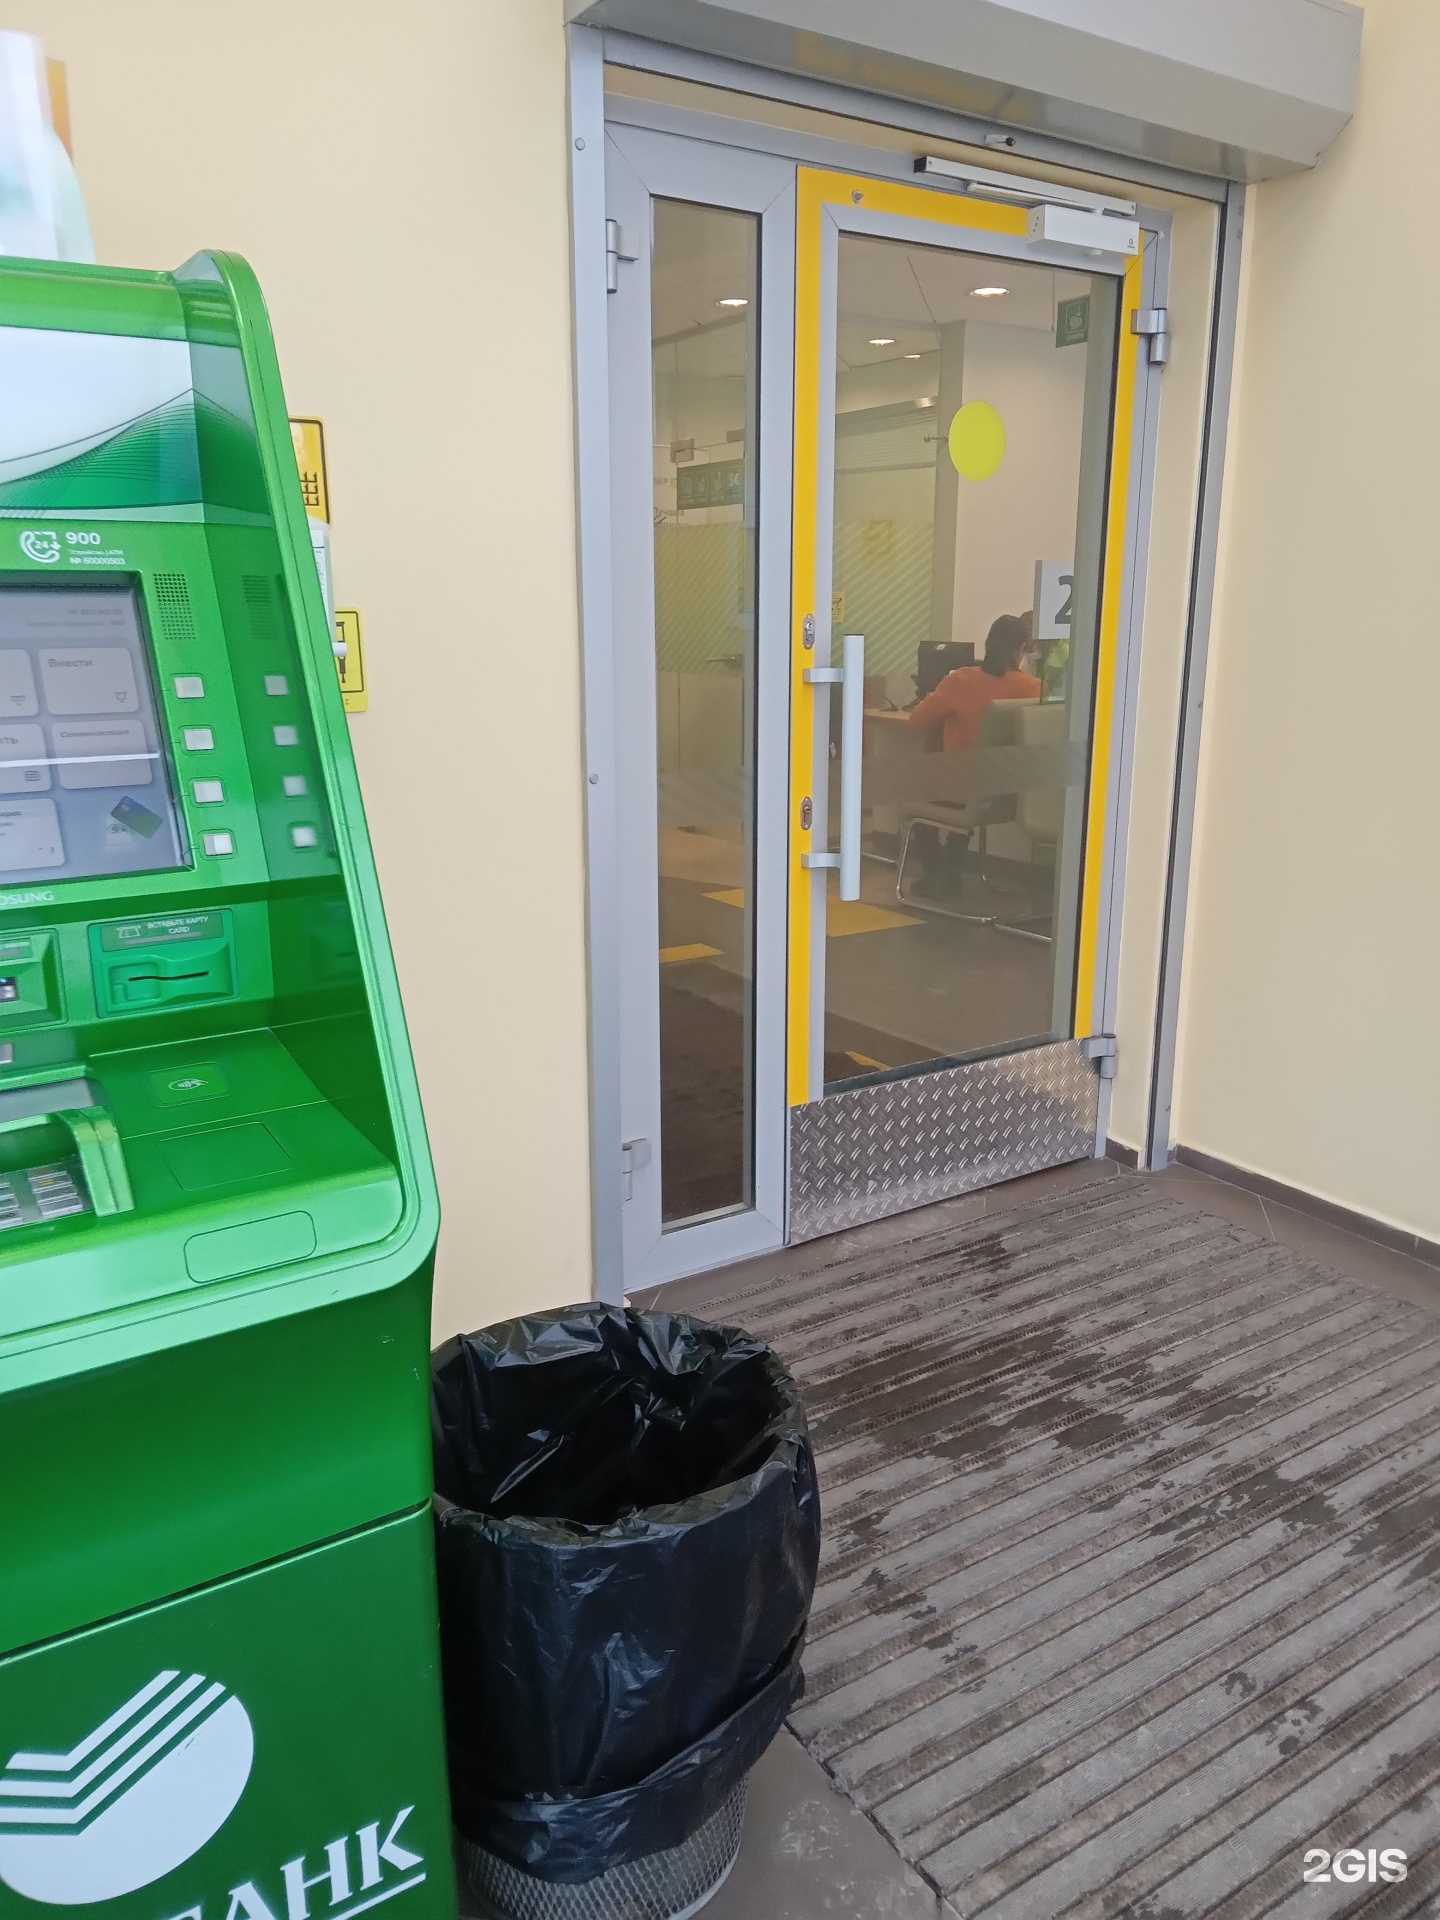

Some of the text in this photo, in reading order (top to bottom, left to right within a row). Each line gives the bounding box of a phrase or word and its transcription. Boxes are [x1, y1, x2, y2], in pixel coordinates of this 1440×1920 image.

[65, 532, 100, 544] 900
[1055, 575, 1072, 625] 2
[165, 1804, 425, 1920] АНК
